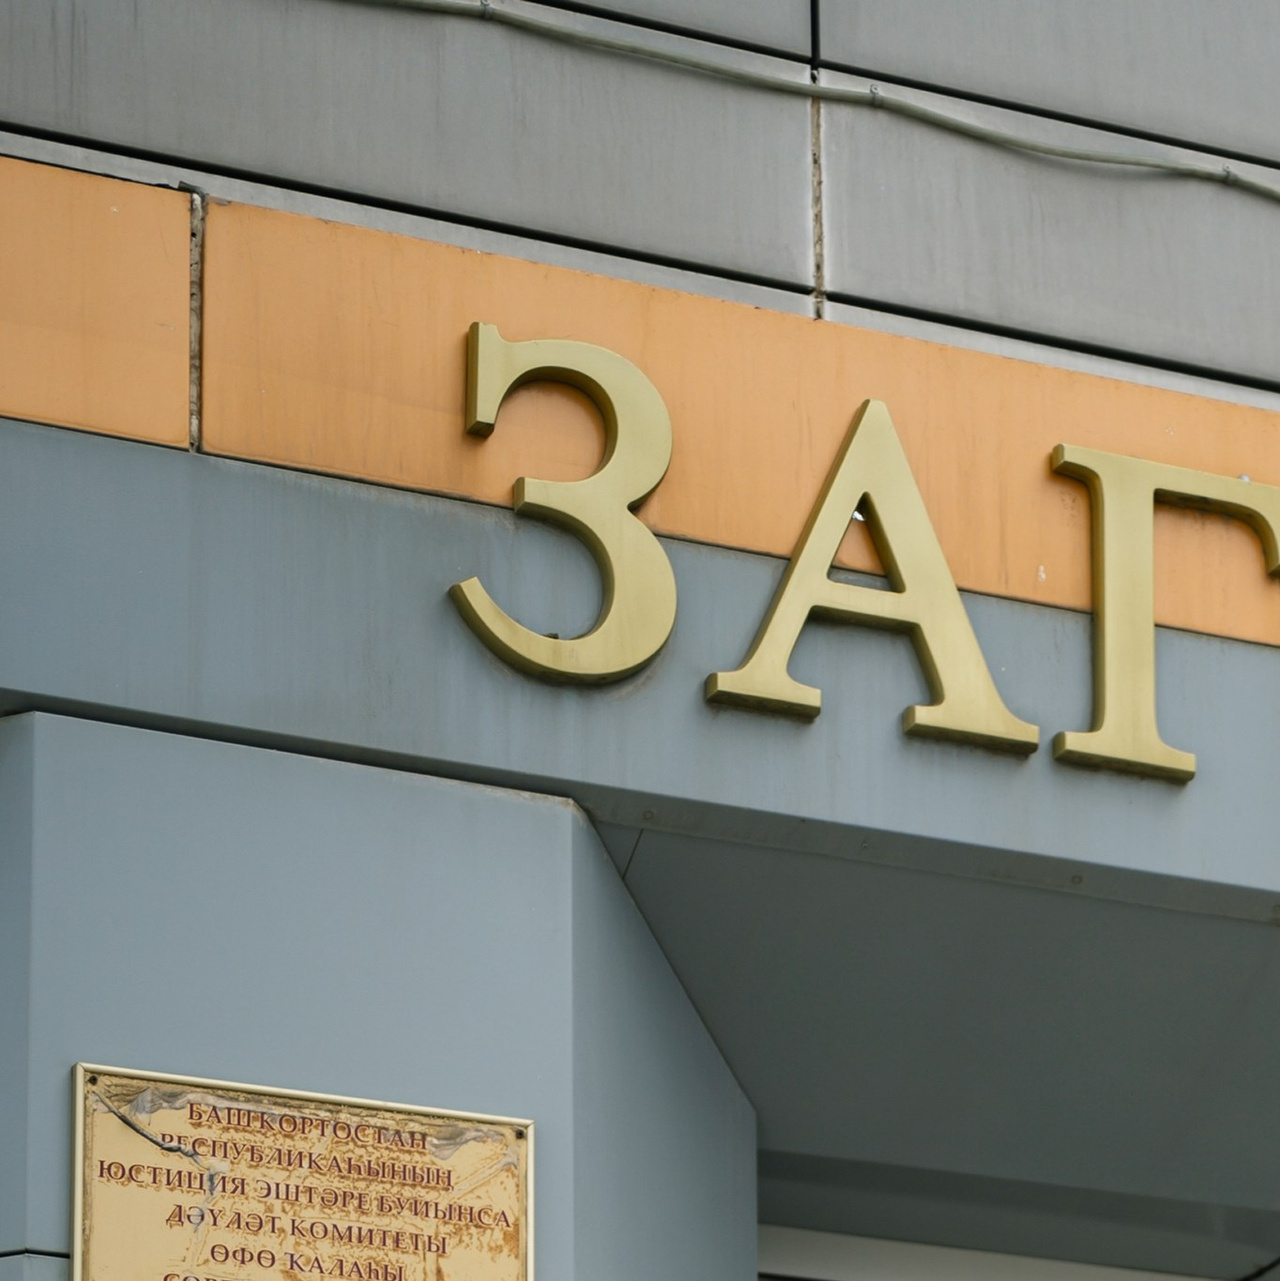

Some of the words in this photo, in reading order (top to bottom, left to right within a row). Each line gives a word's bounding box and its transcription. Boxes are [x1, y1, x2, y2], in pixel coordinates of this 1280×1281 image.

[99, 1160, 246, 1197] ЮСТИЦИЯ
[258, 1181, 370, 1210] ЭШТӘРЕ
[379, 1193, 511, 1228] БУЙЫНСА
[291, 1219, 448, 1254] КОМИТЕТЫ
[211, 1244, 276, 1268] ӨФӨ
